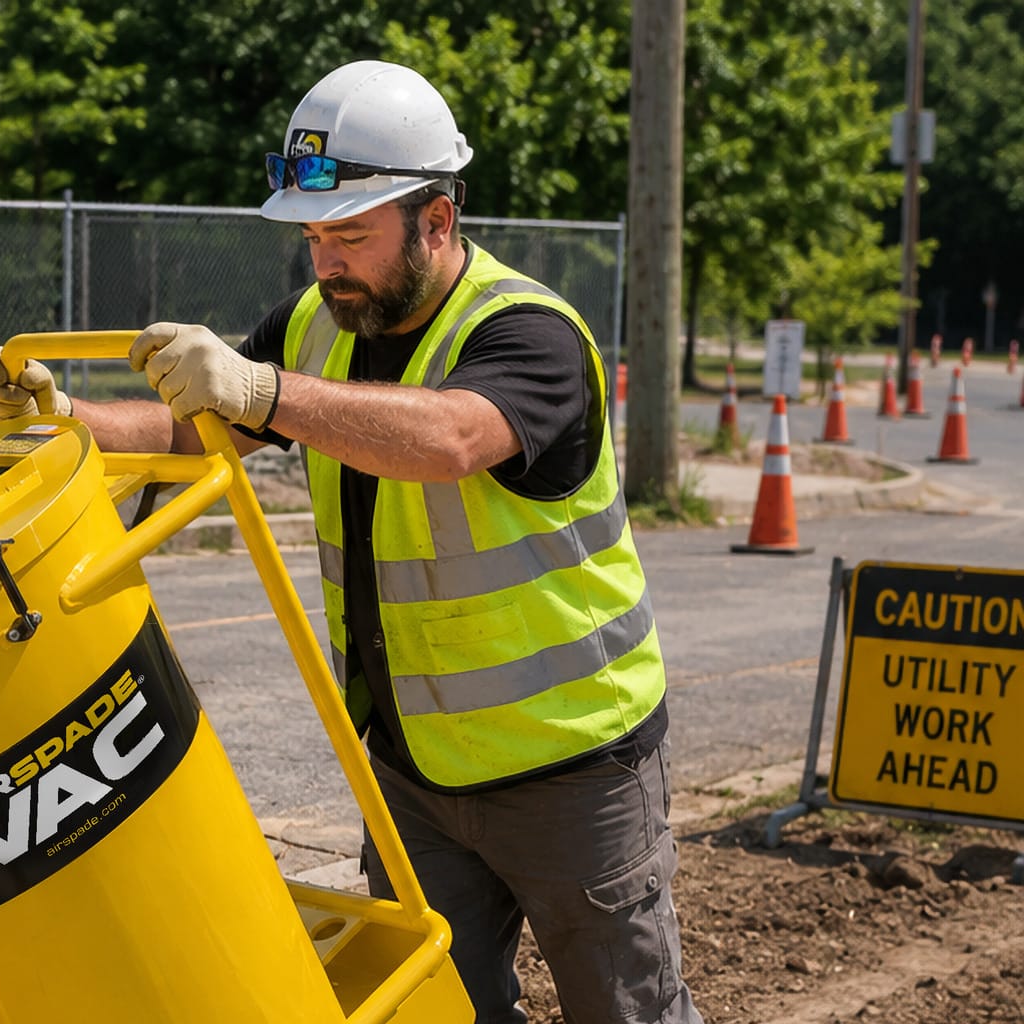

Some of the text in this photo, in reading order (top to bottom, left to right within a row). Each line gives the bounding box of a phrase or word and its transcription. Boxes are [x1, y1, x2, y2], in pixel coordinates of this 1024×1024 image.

[883, 653, 1017, 698] UTILITY
[895, 703, 995, 746] WORK
[877, 750, 998, 795] AHEAD
[46, 792, 127, 857] airspade.com
